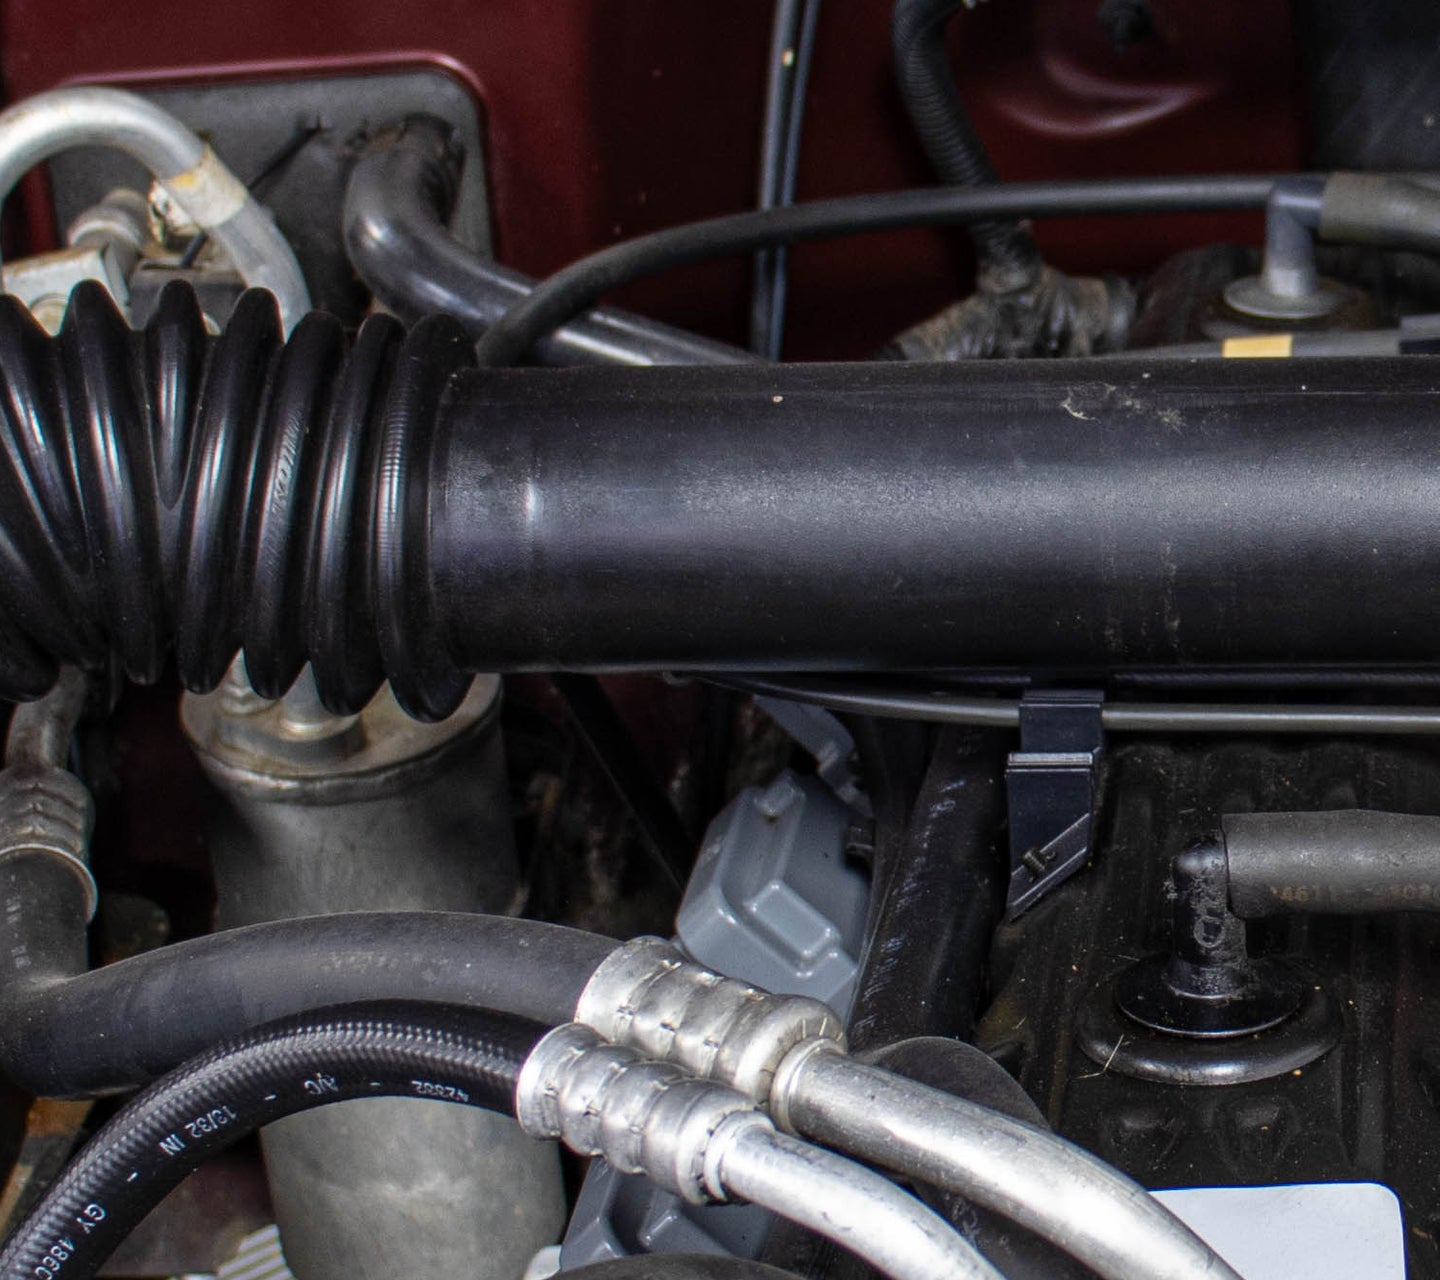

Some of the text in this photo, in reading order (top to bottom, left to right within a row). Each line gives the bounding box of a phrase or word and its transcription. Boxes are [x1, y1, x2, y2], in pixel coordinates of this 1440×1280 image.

[184, 1104, 238, 1140] 13/32
[159, 1133, 188, 1157] IN
[77, 1202, 108, 1236] GY
